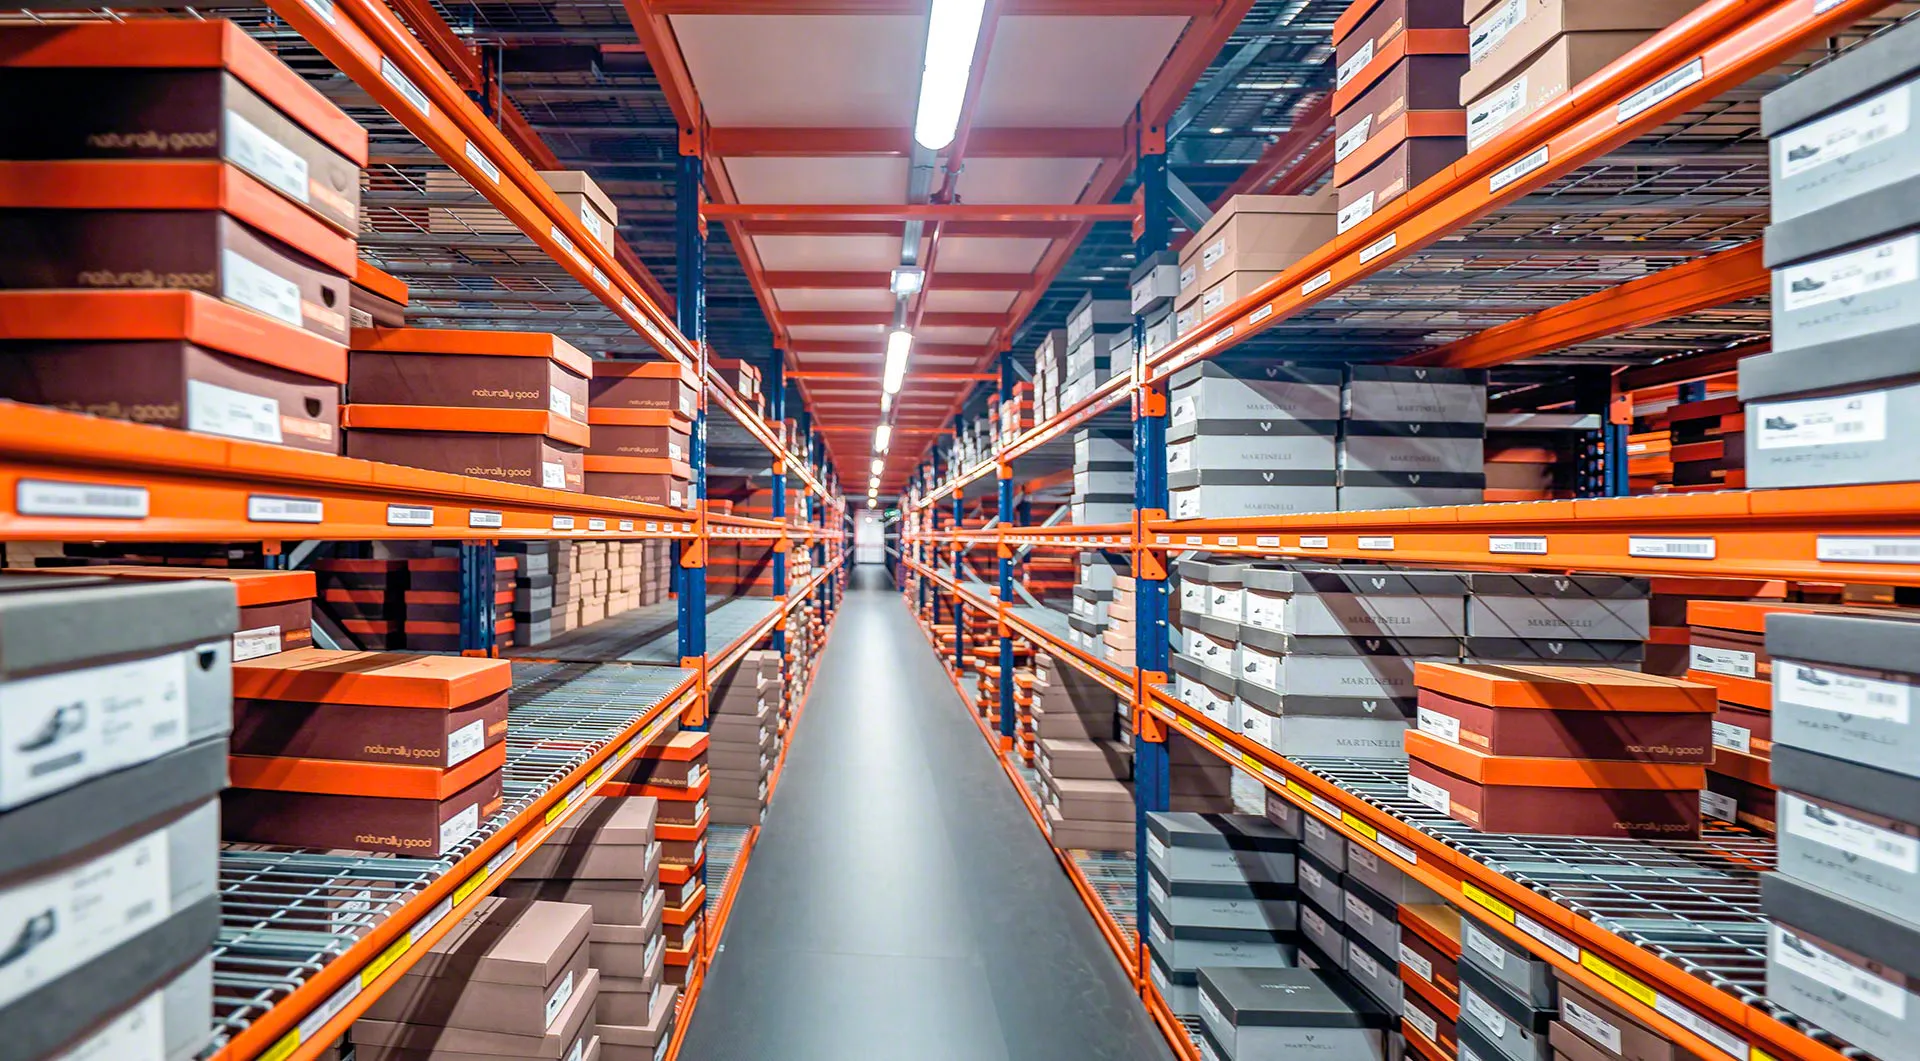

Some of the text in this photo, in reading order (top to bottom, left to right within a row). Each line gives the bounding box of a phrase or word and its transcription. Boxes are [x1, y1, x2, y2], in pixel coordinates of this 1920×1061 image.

[169, 129, 217, 151] good
[166, 270, 216, 287] good
[472, 389, 540, 400] naturally good
[1246, 403, 1296, 411] MARTINELLI
[1241, 452, 1292, 461] MARTINELLI
[1770, 450, 1870, 464] MARTINELLI
[465, 467, 531, 477] naturally good
[1244, 502, 1295, 511] MARTINELLI
[1349, 616, 1411, 625] MARTINELLI
[1527, 618, 1592, 628] MARTINELLI
[1341, 677, 1404, 687] MARTINELLI
[364, 745, 440, 759] naturally good
[1626, 745, 1704, 757] naturally good
[355, 834, 432, 849] naturally good
